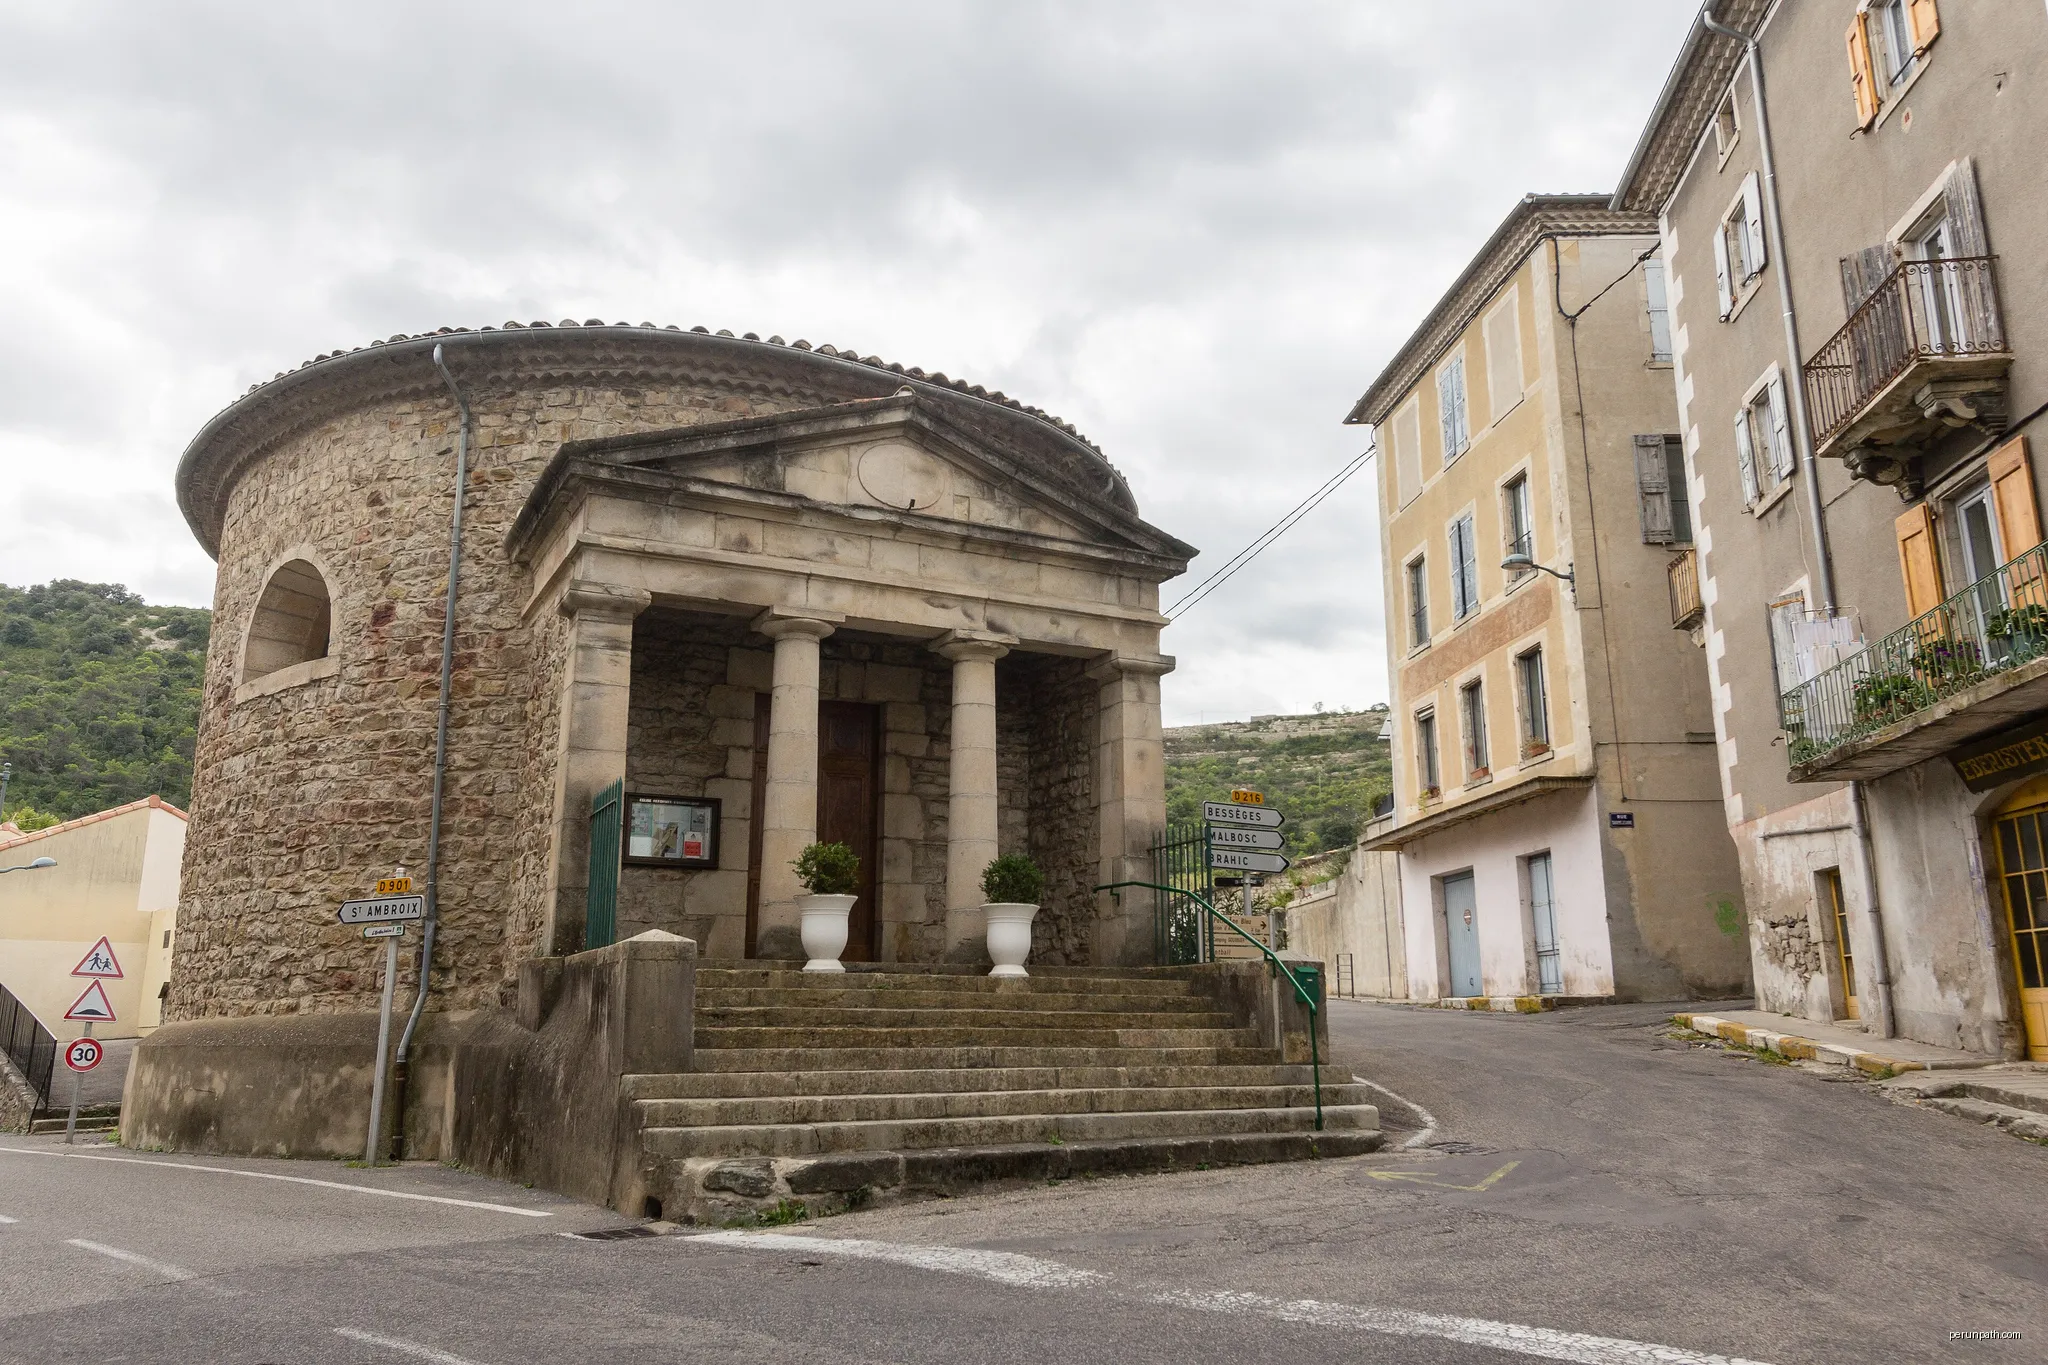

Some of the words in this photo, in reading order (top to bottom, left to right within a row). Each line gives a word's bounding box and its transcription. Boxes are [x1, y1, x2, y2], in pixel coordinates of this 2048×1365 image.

[1234, 791, 1240, 800] D
[1243, 793, 1261, 802] 216
[1207, 807, 1262, 821] BESSÈGES
[1210, 831, 1257, 843] MALBOSC
[379, 881, 386, 892] D
[388, 880, 408, 891] 901
[367, 902, 418, 917] AMBROIX
[73, 1047, 96, 1062] 30
